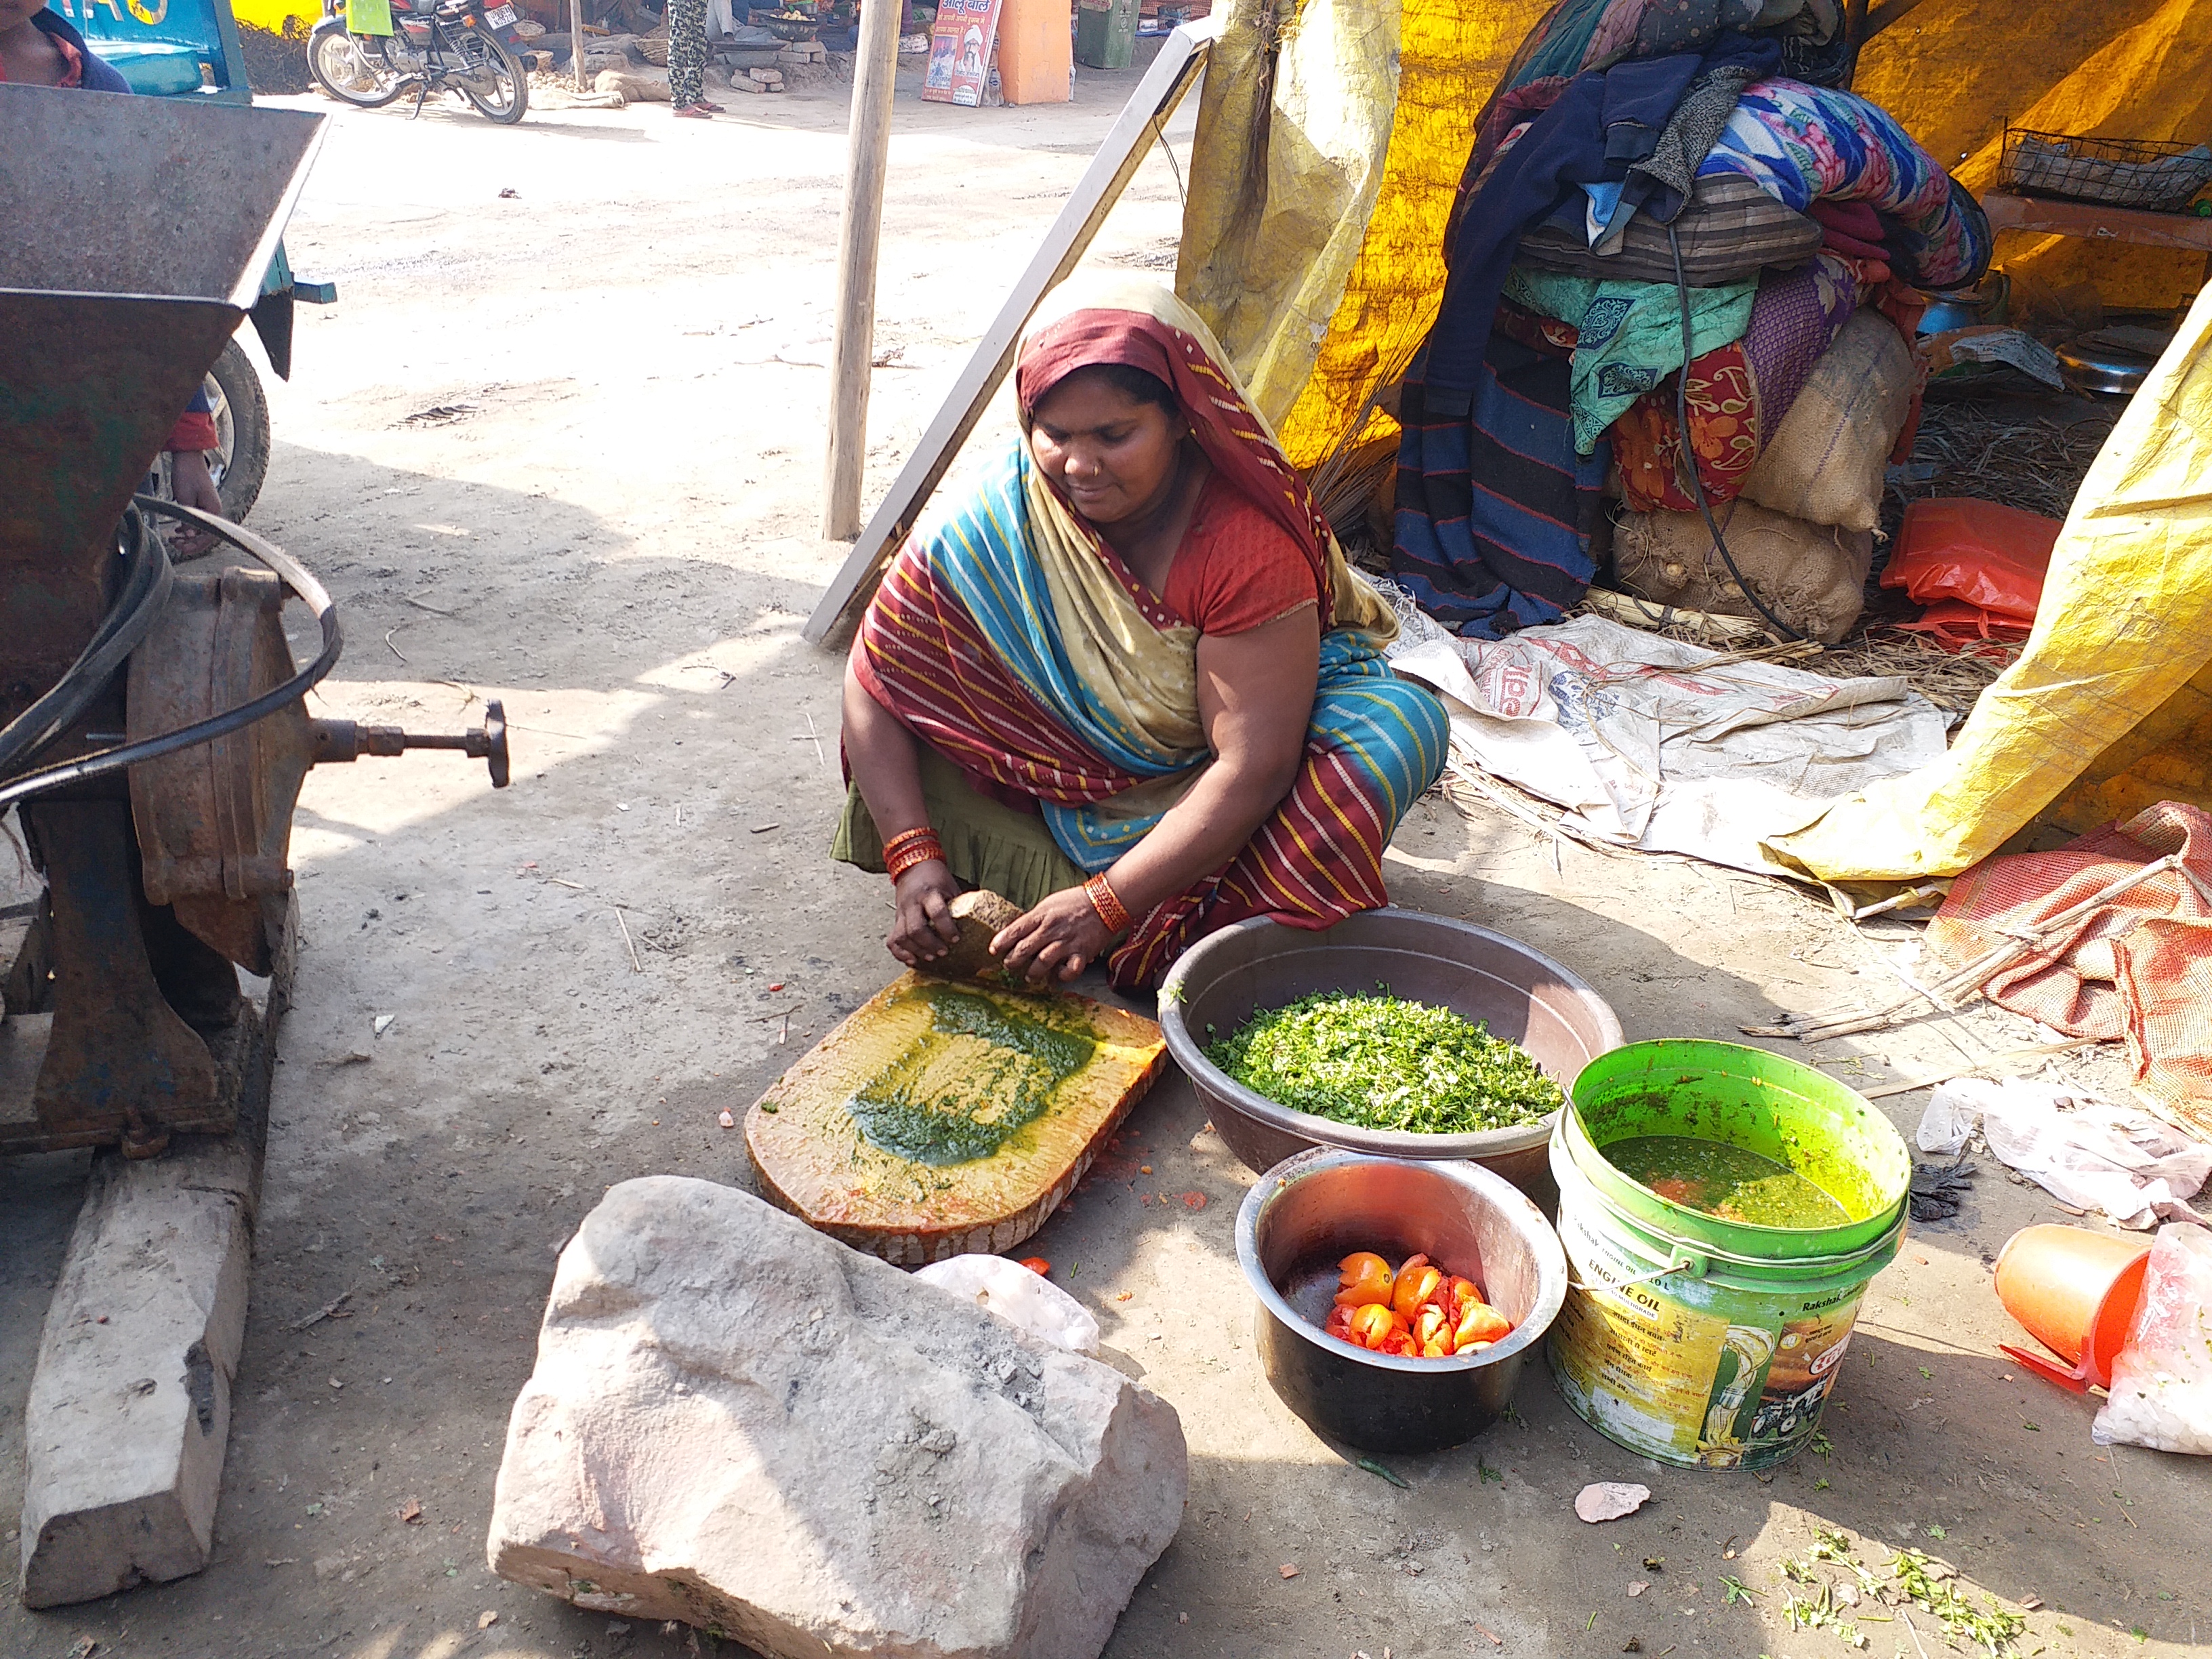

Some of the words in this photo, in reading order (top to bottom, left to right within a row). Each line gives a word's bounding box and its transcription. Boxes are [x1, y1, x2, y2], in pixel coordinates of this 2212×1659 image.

[1574, 1215, 1599, 1246] kshak
[1625, 1265, 1637, 1275] OIL
[1618, 1295, 1656, 1319] MULTIGRADE
[1637, 1293, 1660, 1313] OIL
[1802, 1294, 1841, 1312] Rakshak
